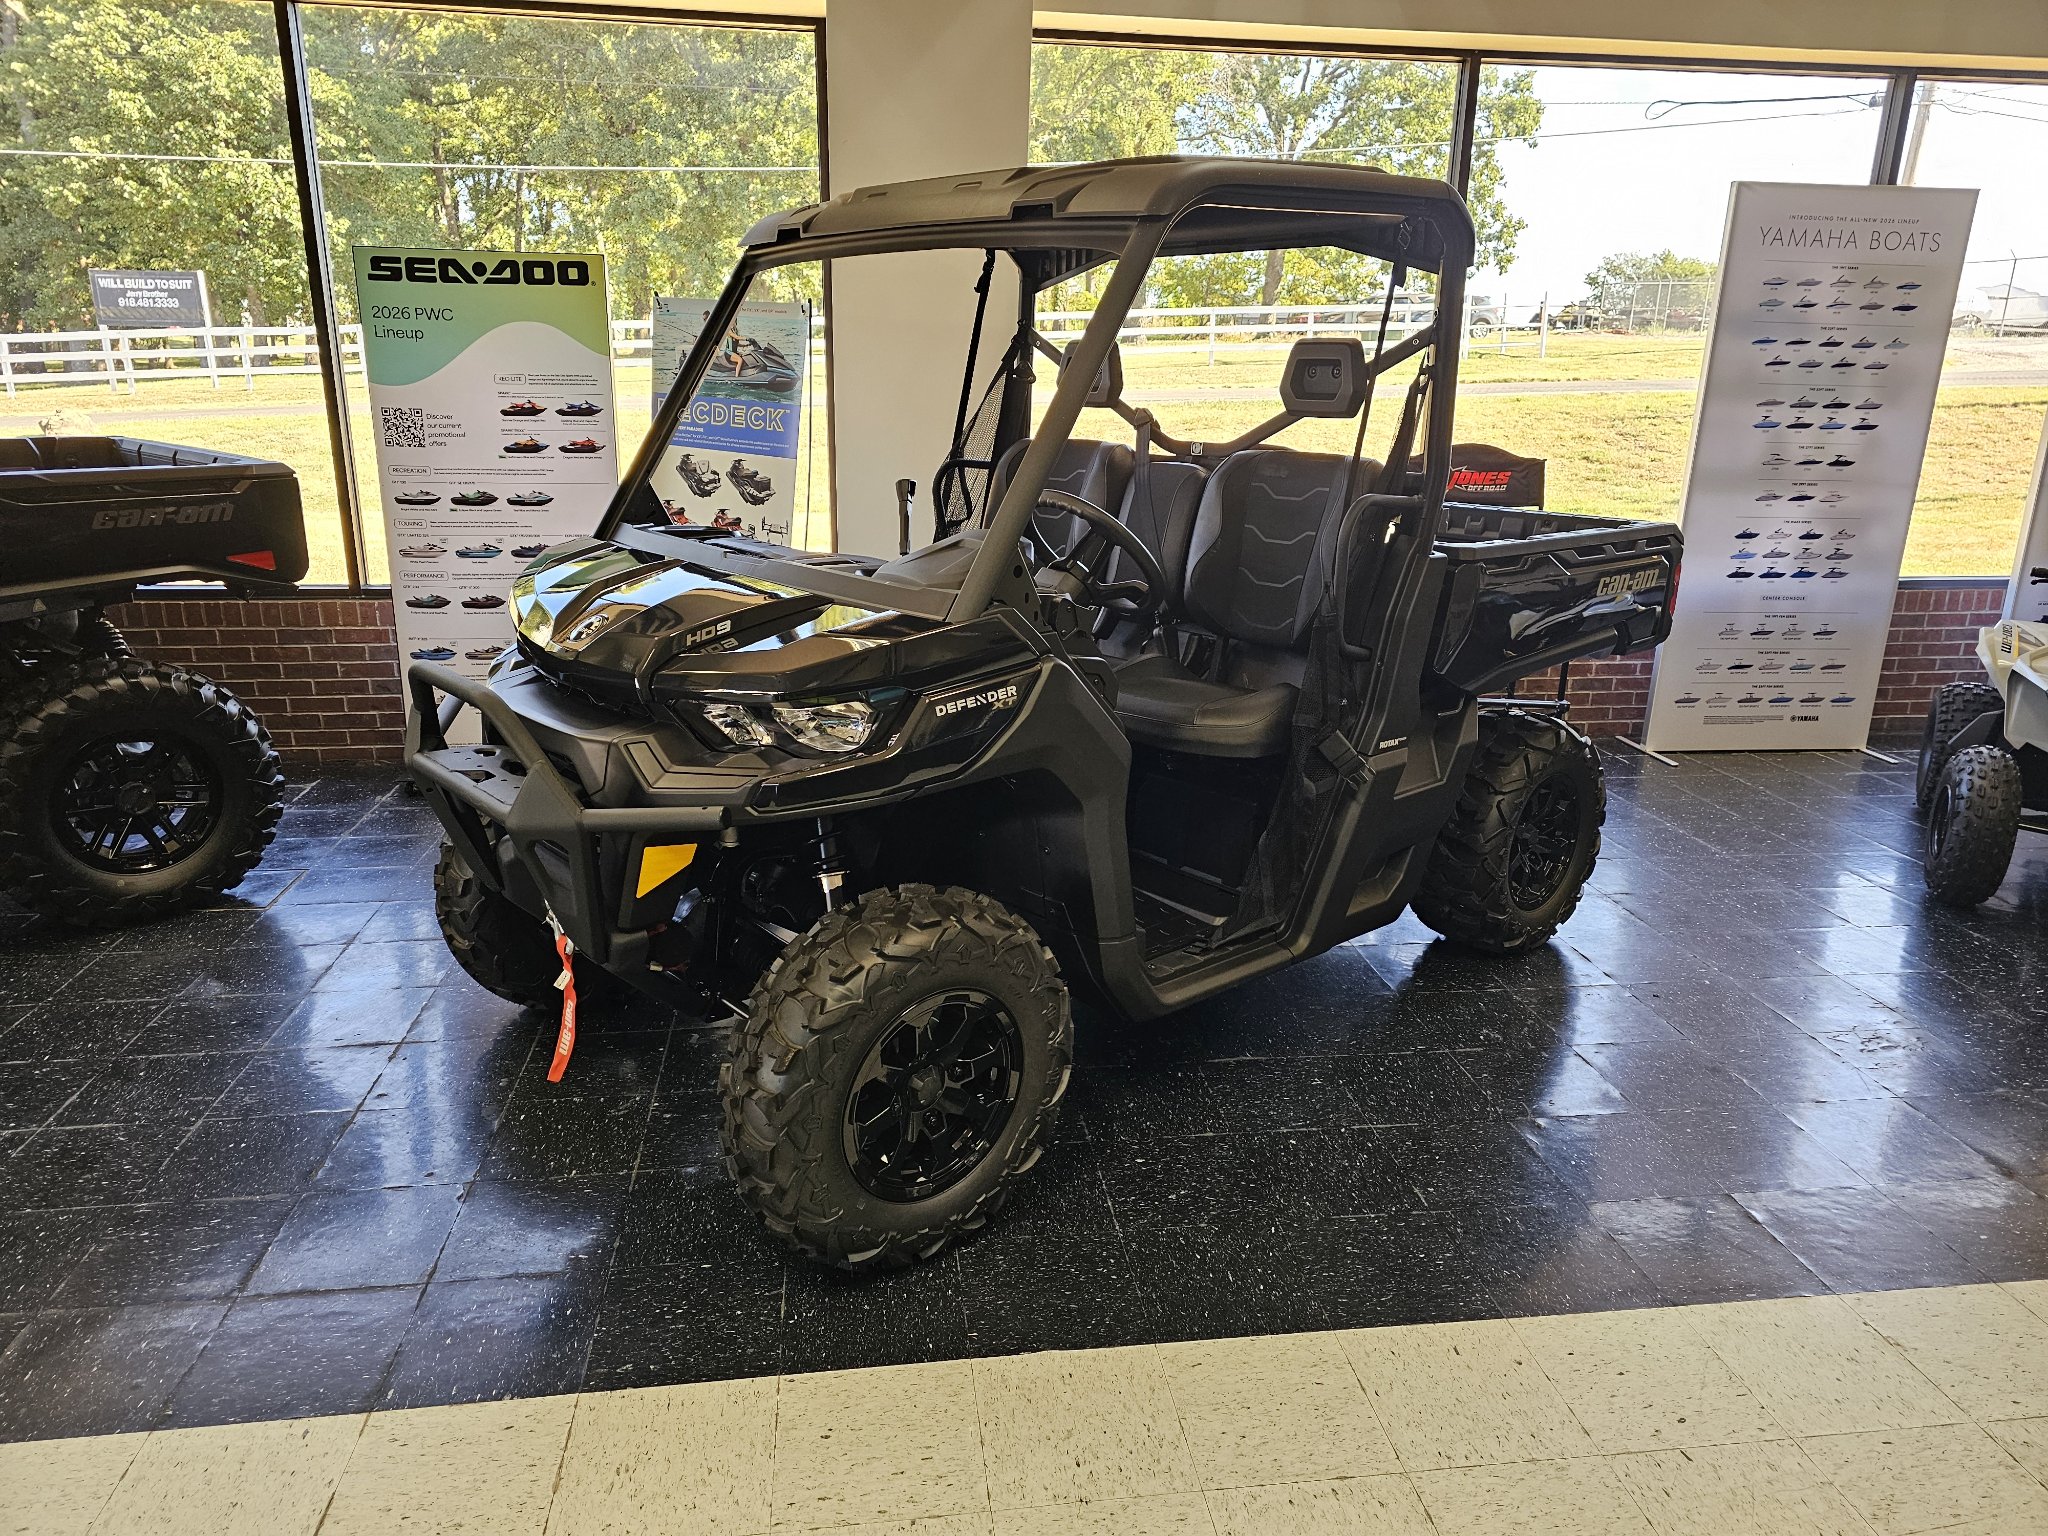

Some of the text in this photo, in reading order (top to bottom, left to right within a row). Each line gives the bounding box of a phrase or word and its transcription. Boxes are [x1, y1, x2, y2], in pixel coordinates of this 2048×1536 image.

[1760, 226, 1942, 252] YAMAHA BOATS
[98, 278, 192, 289] WILL BUILD TO SUIT
[372, 306, 453, 321] 2026 PWC
[374, 325, 424, 342] Lineup
[1447, 471, 1512, 490] JONES
[1596, 569, 1659, 597] can-am
[686, 620, 731, 646] HD9
[935, 686, 1017, 716] DEFENDER
[992, 696, 1017, 710] XT
[1379, 739, 1399, 749] ROTAX
